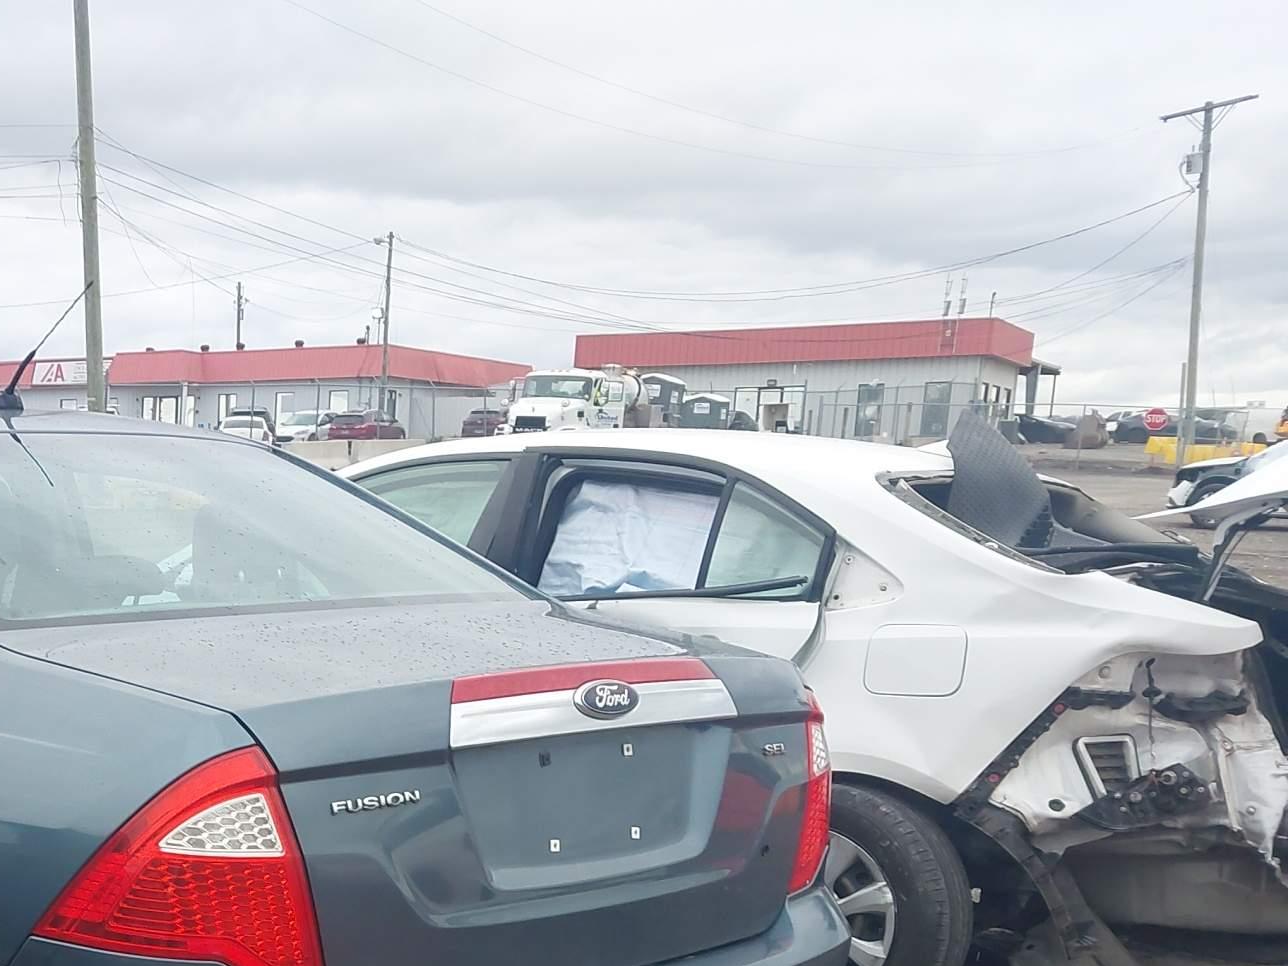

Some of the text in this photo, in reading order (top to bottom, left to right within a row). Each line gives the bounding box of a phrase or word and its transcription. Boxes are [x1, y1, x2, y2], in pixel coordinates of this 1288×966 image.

[1146, 414, 1167, 423] STOP
[595, 684, 631, 708] Ford
[762, 743, 787, 756] SEL
[330, 789, 421, 815] FUSION
